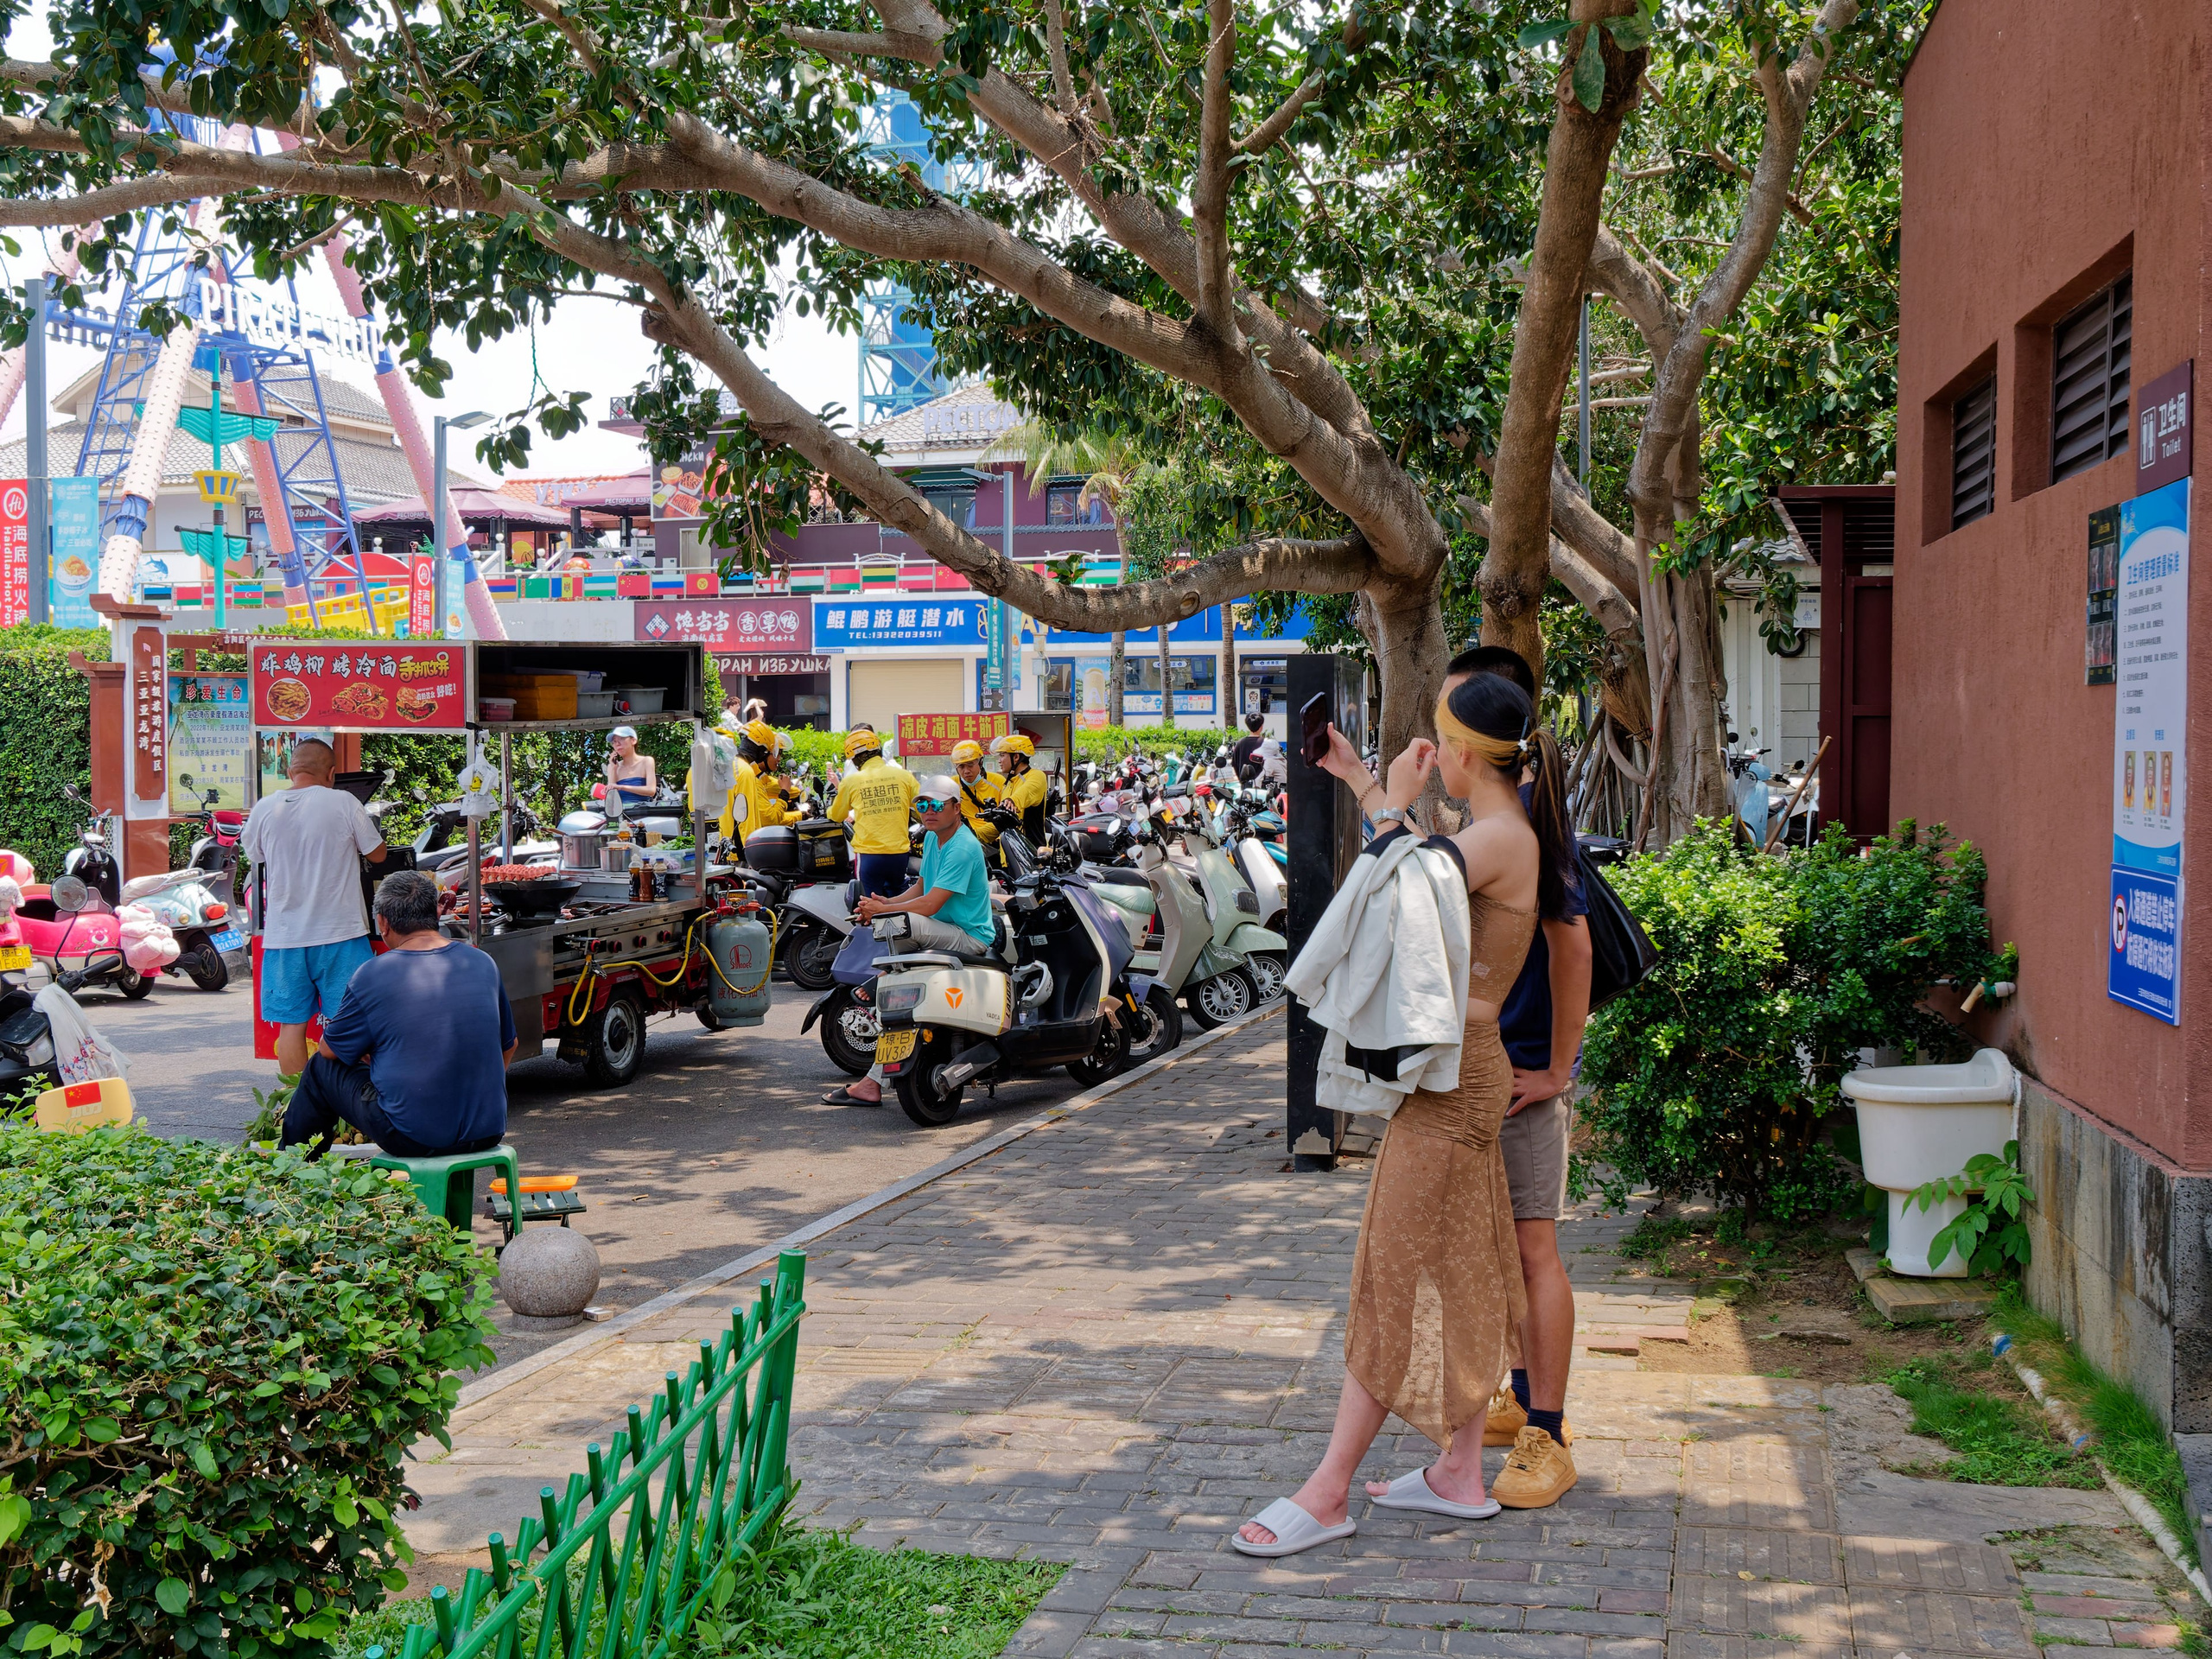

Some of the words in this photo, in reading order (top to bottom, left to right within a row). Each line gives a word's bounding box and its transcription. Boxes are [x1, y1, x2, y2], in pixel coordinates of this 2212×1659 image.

[199, 277, 318, 350] PIRATE
[320, 312, 386, 365] SHIP
[923, 401, 1036, 434] РЕСТОР
[2158, 391, 2186, 437] 卫生间
[2162, 436, 2181, 458] Toilet
[3, 526, 13, 578] Haidilao
[13, 524, 28, 625] 海底捞火锅
[3, 580, 13, 603] Hot
[3, 605, 13, 626] Pot
[675, 610, 730, 632] 馋当当
[738, 610, 799, 634] 香草鸭
[825, 607, 965, 630] 鲲鹏游艇潜水
[849, 630, 942, 639] TEL:13322039511
[259, 650, 325, 678] 炸鸡柳
[331, 650, 397, 678] 烤冷面
[398, 651, 450, 683] 手抓饼
[759, 657, 831, 673] ИЗБУШКА
[186, 684, 242, 701] 珍爱生命
[137, 671, 150, 750] 三亚亚龙湾
[150, 655, 162, 772] 国家级旅游度假区
[900, 715, 929, 740] 凉皮
[931, 715, 960, 739] 凉面
[963, 714, 1007, 739] 牛筋面
[860, 783, 899, 801] 逛超市
[861, 796, 901, 810] 上美团外卖
[717, 984, 766, 1000] 液化石油气
[886, 1032, 911, 1046] 琼·B
